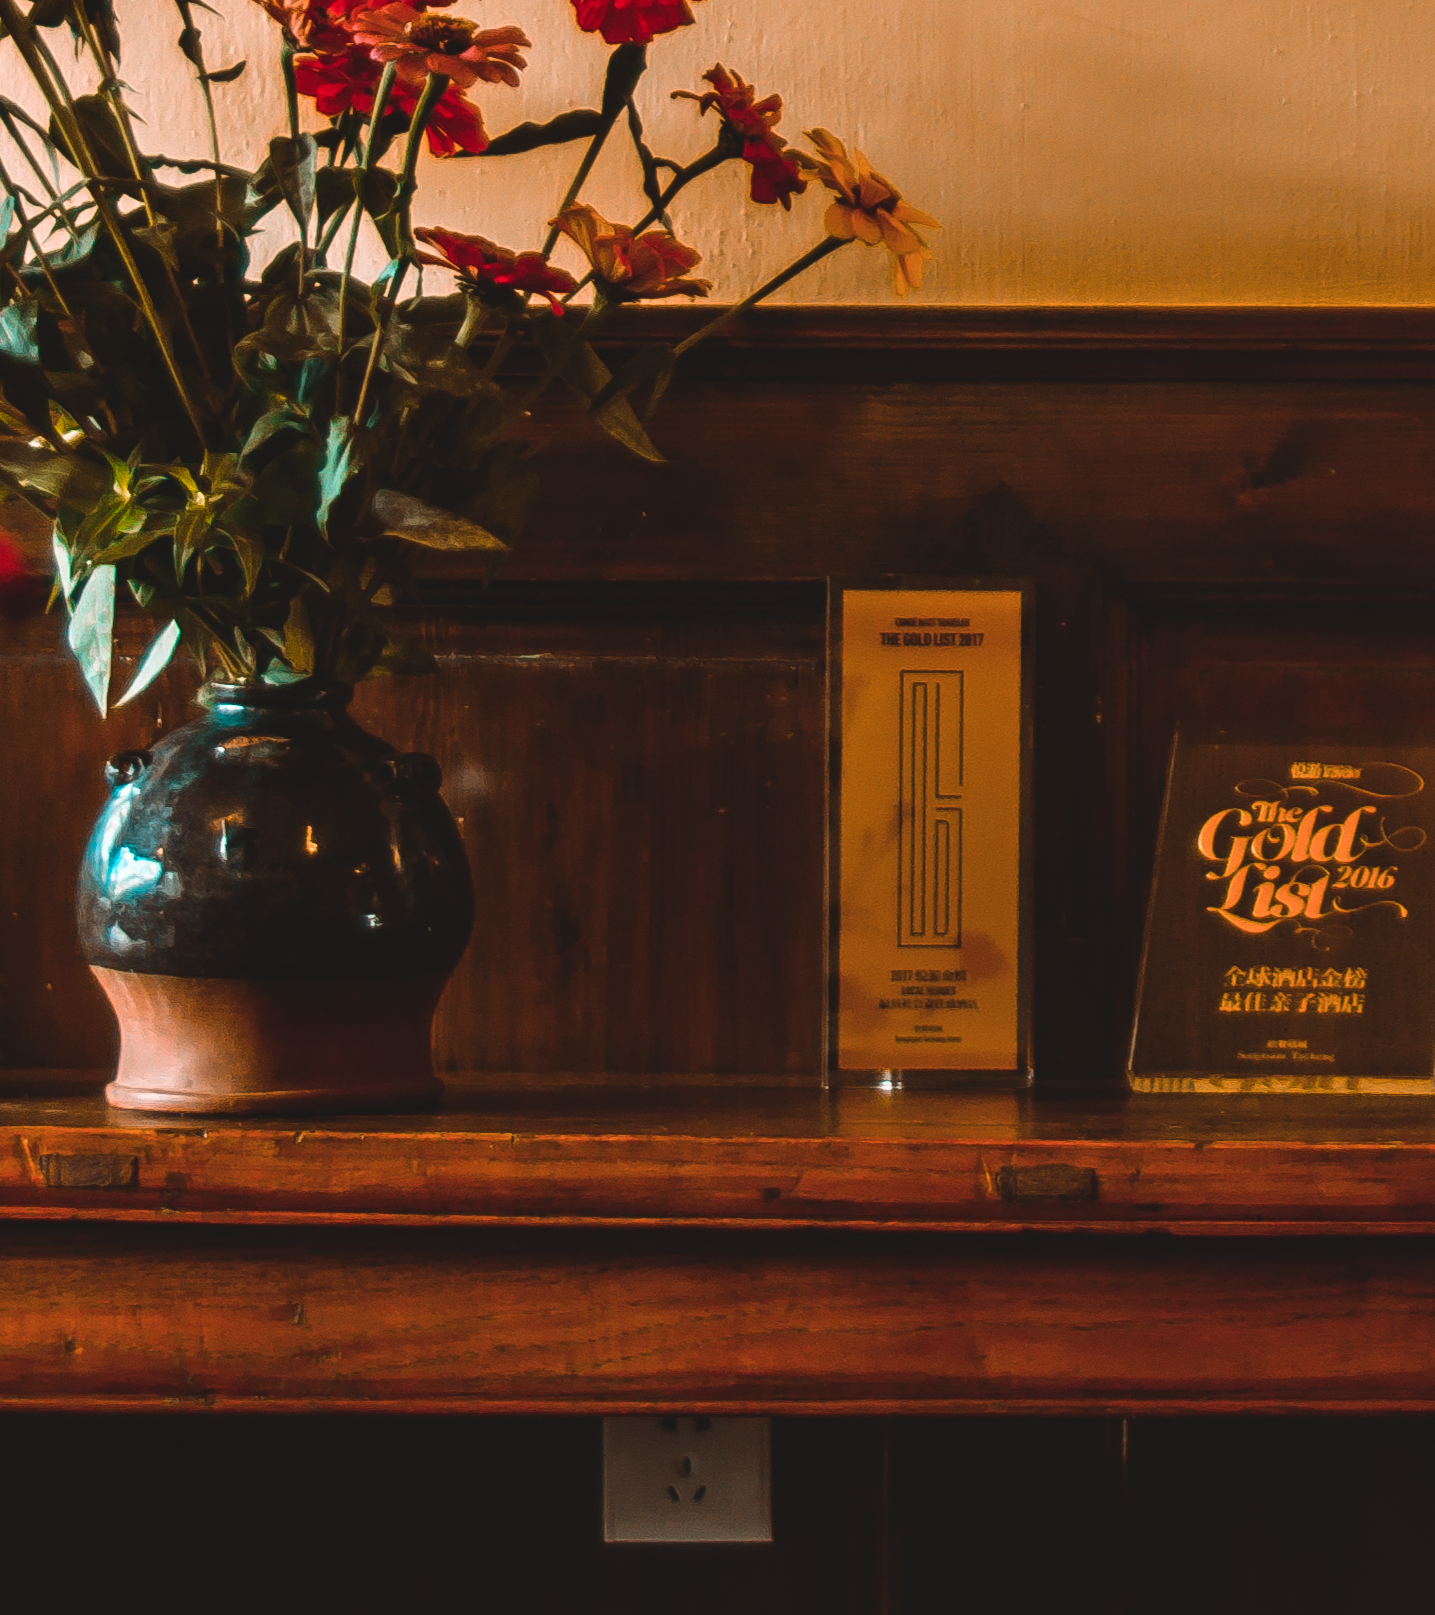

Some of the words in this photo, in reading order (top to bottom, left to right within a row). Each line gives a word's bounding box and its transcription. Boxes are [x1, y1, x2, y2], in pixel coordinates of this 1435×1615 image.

[880, 632, 902, 646] THE
[903, 632, 932, 646] GOLD
[933, 632, 957, 646] LIST
[959, 632, 984, 646] 2017
[1251, 800, 1304, 823] The
[1197, 804, 1378, 880] Gold
[1205, 862, 1333, 934] List
[1331, 865, 1399, 889] 2016
[1224, 965, 1368, 989] 全球酒店金榜
[1219, 991, 1365, 1014] 最佳亲子酒店
